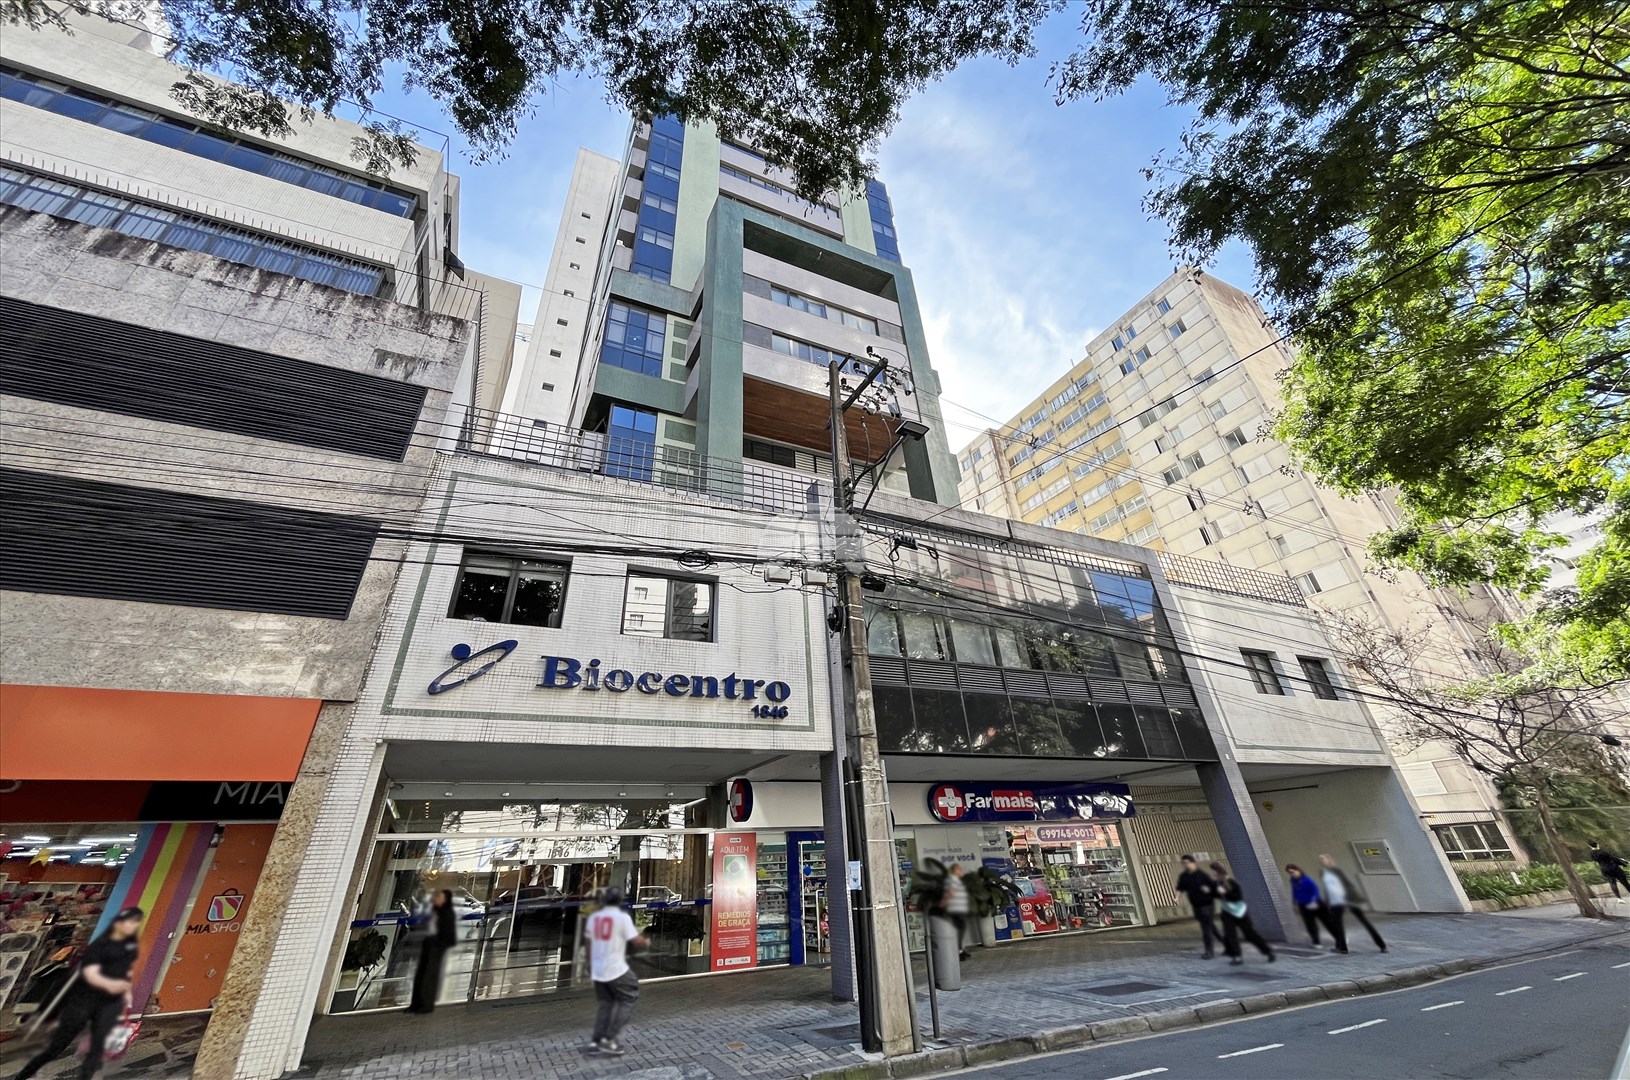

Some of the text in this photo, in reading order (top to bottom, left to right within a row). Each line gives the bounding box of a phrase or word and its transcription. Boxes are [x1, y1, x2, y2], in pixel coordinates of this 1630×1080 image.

[536, 655, 791, 702] Biocentro
[751, 704, 789, 719] 1846
[213, 782, 284, 805] MIA
[964, 791, 1035, 809] Farmais
[185, 922, 241, 935] MIASHO
[593, 916, 614, 941] 10
[718, 919, 751, 928] DE GRAÇA
